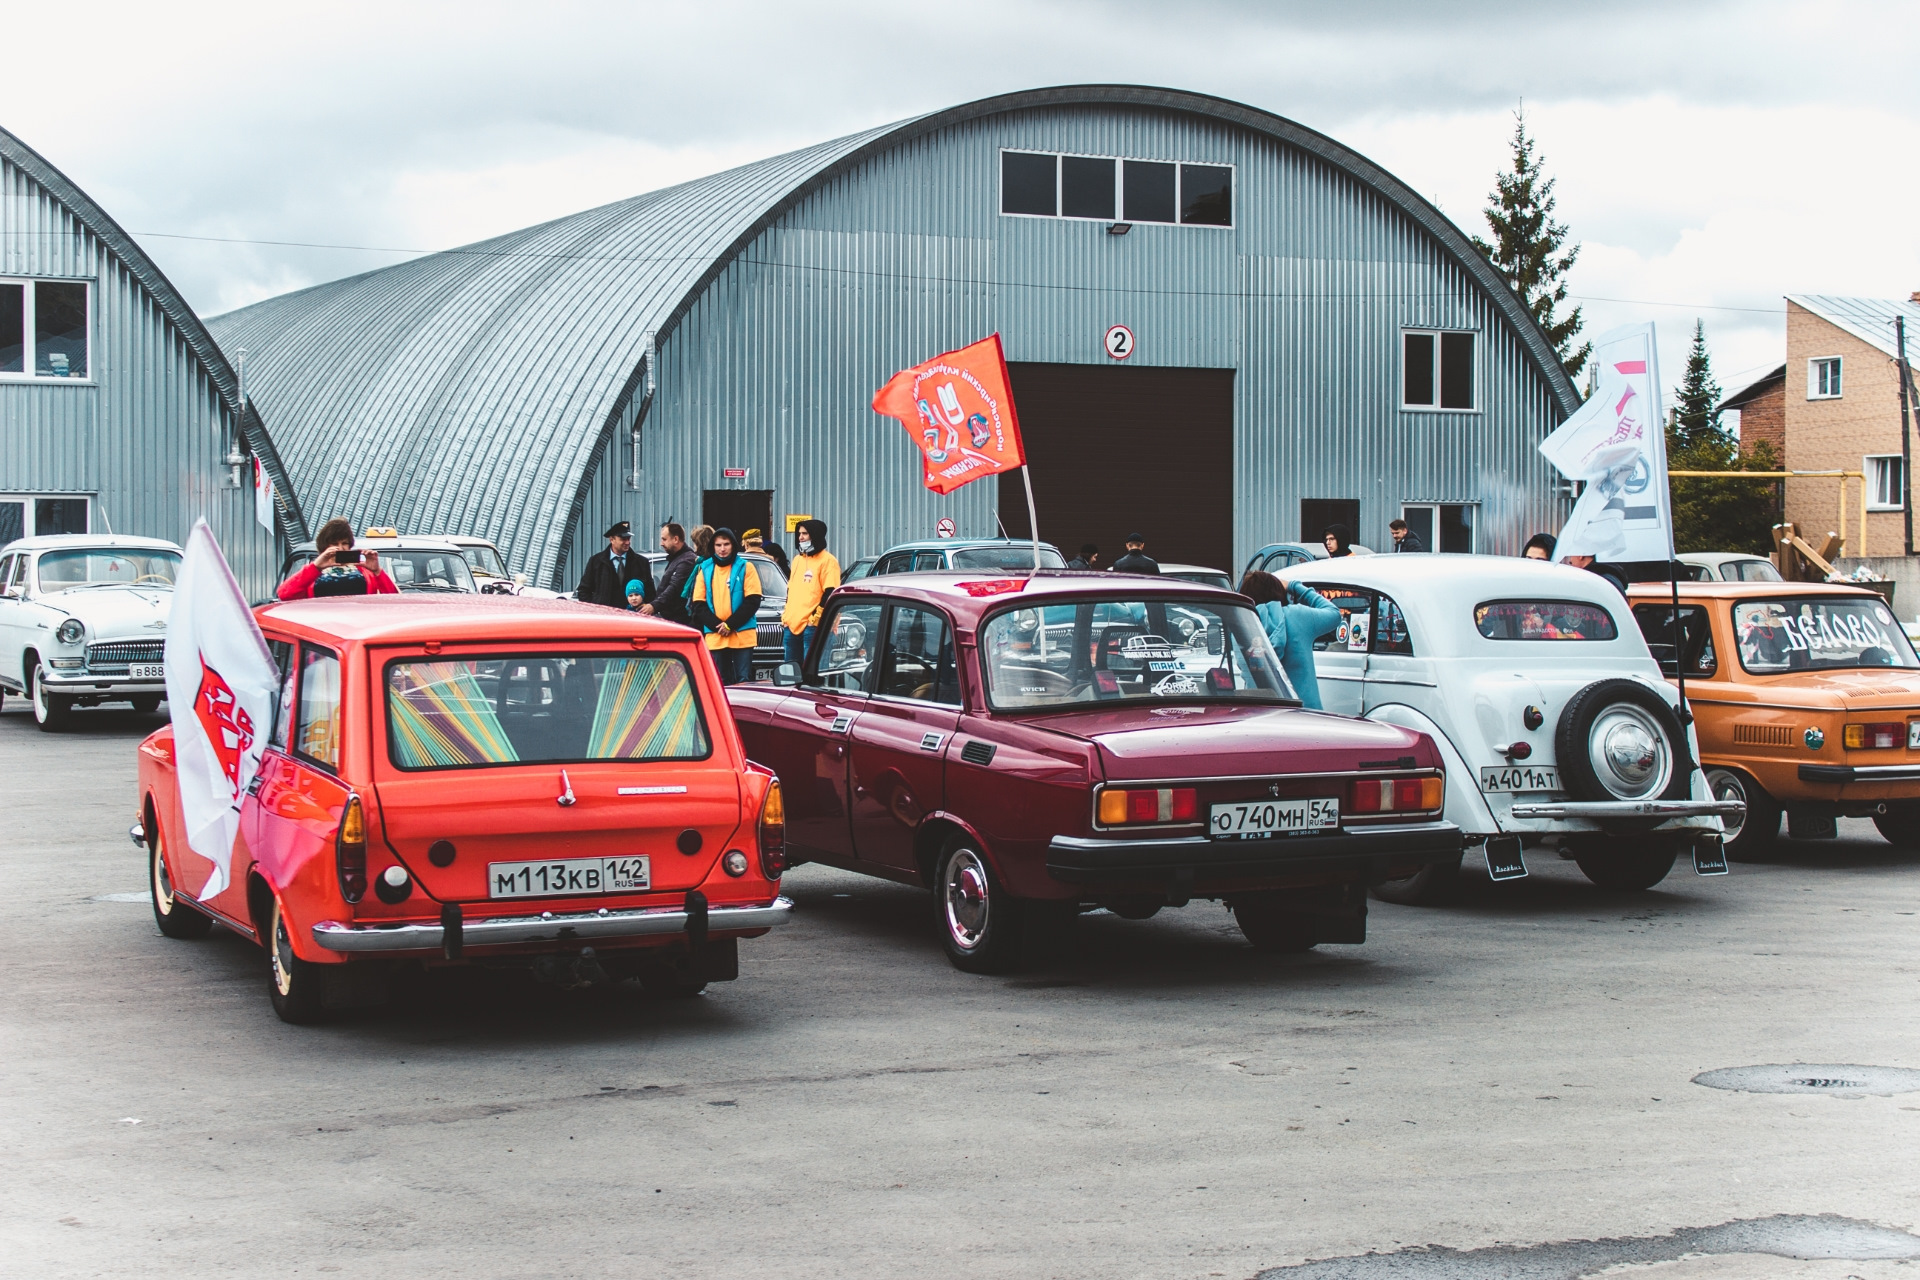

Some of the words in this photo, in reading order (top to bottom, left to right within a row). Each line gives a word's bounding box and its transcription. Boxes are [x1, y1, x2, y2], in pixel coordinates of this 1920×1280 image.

[1113, 331, 1126, 353] 2
[136, 666, 164, 677] В888
[1150, 661, 1187, 670] MAHLE
[1218, 804, 1304, 831] О740МН
[1310, 800, 1332, 819] 54
[1308, 818, 1325, 827] RUS
[497, 864, 600, 894] М113КВ
[606, 859, 644, 880] 142
[614, 879, 634, 888] RUS
